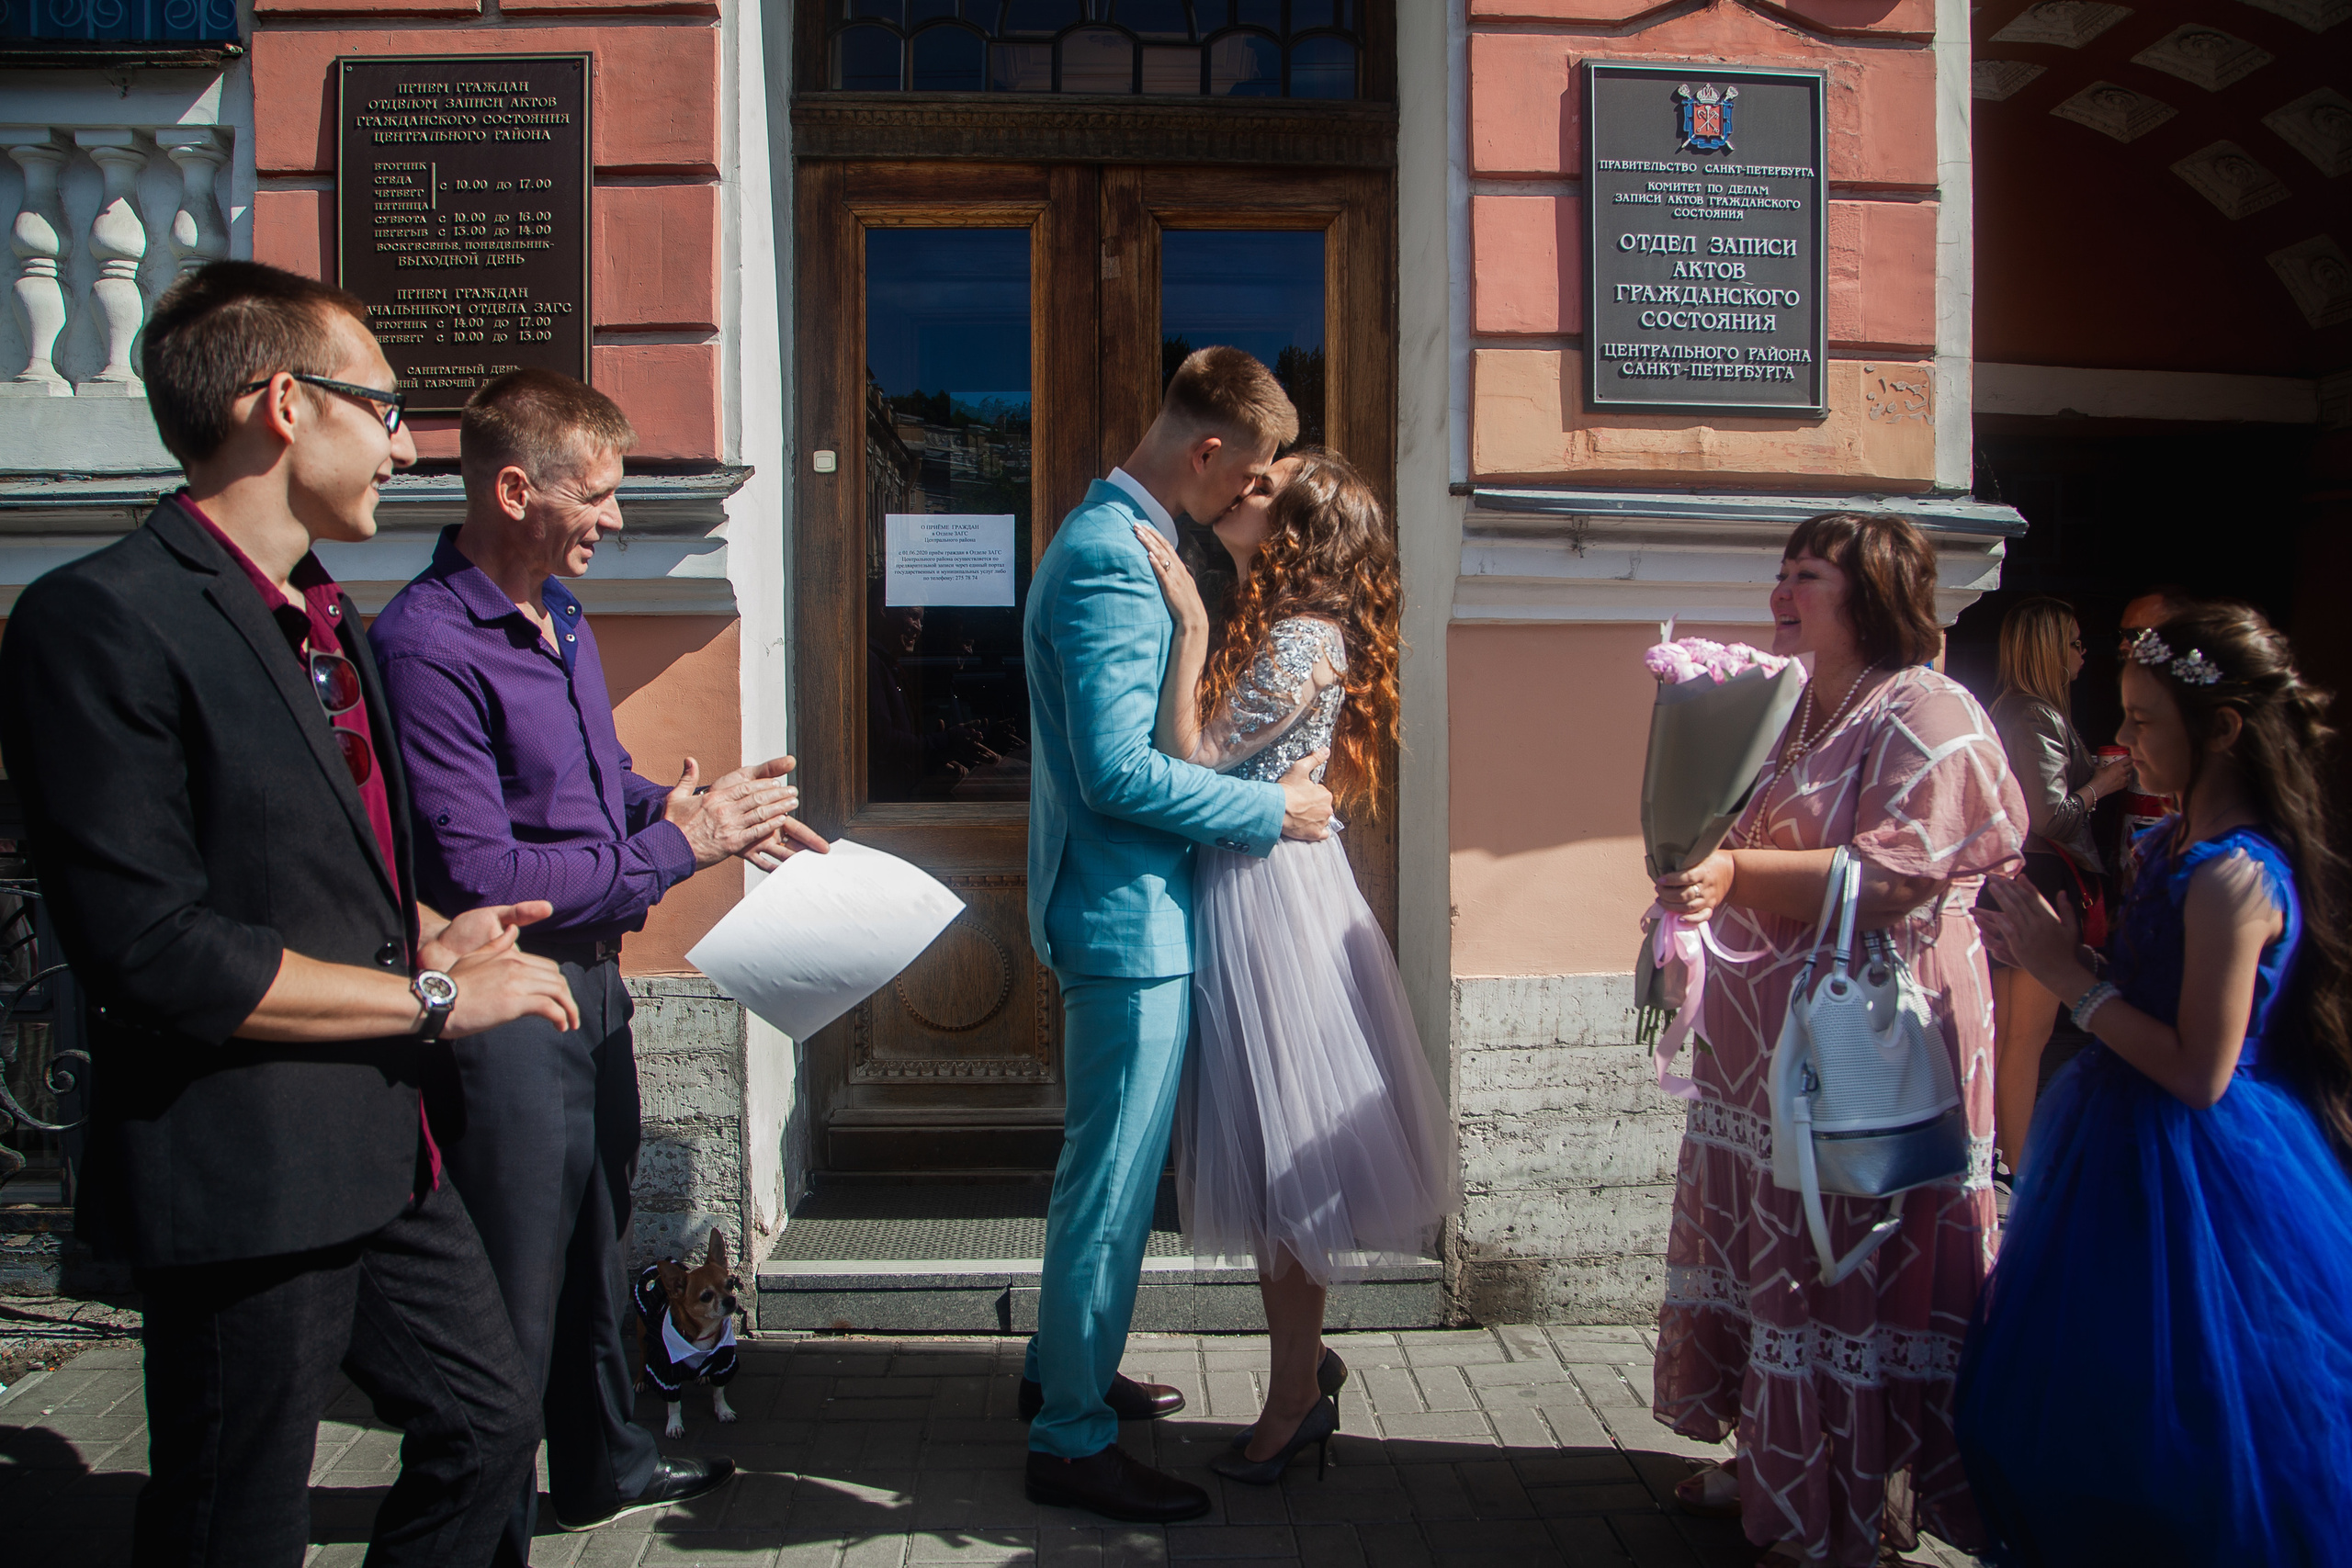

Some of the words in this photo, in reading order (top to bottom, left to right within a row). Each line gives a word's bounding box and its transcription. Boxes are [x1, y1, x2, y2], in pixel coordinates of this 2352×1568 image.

[398, 84, 448, 95] ПРИЕМ
[456, 82, 529, 94] ГРАЖДАН
[368, 99, 437, 111] ОТДЕЛОМ
[446, 98, 503, 108] ЗАПИСИ
[511, 97, 557, 107] АКТОВ
[356, 115, 476, 127] ГРАЖДАНСКОГО
[482, 114, 570, 125] СОСТОЯНИЯ
[374, 130, 486, 143] ЦЕНТРАЛЬНОГО
[495, 128, 551, 141] РАЙОНА
[1600, 160, 1697, 172] ПРАВИТЕЛЬСТВО
[1704, 164, 1815, 177] САНКТ-ПЕТЕРБУРГА
[375, 176, 412, 185] СРЕДА
[456, 179, 488, 190] 10.00
[519, 179, 551, 189] 17.00
[375, 189, 424, 197] ЧЕТВЕРГ
[1647, 181, 1702, 192] КОМИТЕТ
[1707, 184, 1724, 193] ПО
[1728, 185, 1769, 196] ДЕЛАМ
[375, 202, 429, 211] ПЯТНИЦА
[1615, 193, 1661, 203] ЗАПИСИ
[1668, 196, 1703, 205] АКТОВ
[1709, 197, 1801, 209] ГРАЖДАНСКОГО
[375, 215, 426, 224] СУББОТА
[454, 213, 486, 223] 10.00
[518, 211, 551, 222] 16.00
[1674, 209, 1744, 220] СОСТОЯНИЯ
[375, 229, 428, 238] ПЕРЕРЫВ
[518, 225, 551, 235] 14.00
[1620, 233, 1697, 254] ОТДЕЛ
[1710, 237, 1797, 256] ЗАПИСИ
[398, 253, 479, 267] ВЫХОДНОЙ
[485, 254, 525, 266] ДЕНЬ
[1673, 262, 1746, 278] АКТОВ
[397, 288, 447, 299] ПРИЕМ
[456, 288, 528, 299] ГРАЖДАН
[1616, 284, 1800, 307] ГРАЖДАНСКОГО
[366, 304, 461, 315] АЧАЛЬНИКОМ
[469, 304, 526, 315] ОТДЕЛА
[534, 303, 572, 313] ЗАГС
[376, 321, 427, 330] ВТОРНИК
[454, 318, 484, 329] 14.00
[519, 317, 551, 327] 17.00
[1641, 310, 1777, 332] СОСТОЯНИЯ
[454, 332, 484, 342] 10.00
[1604, 344, 1739, 360] ЦЕНТРАЛЬНОГО
[1747, 346, 1812, 363] РАЙОНА
[407, 365, 485, 375] САНИТАРНЫЙ
[424, 378, 475, 389] РАБОЧИЙ
